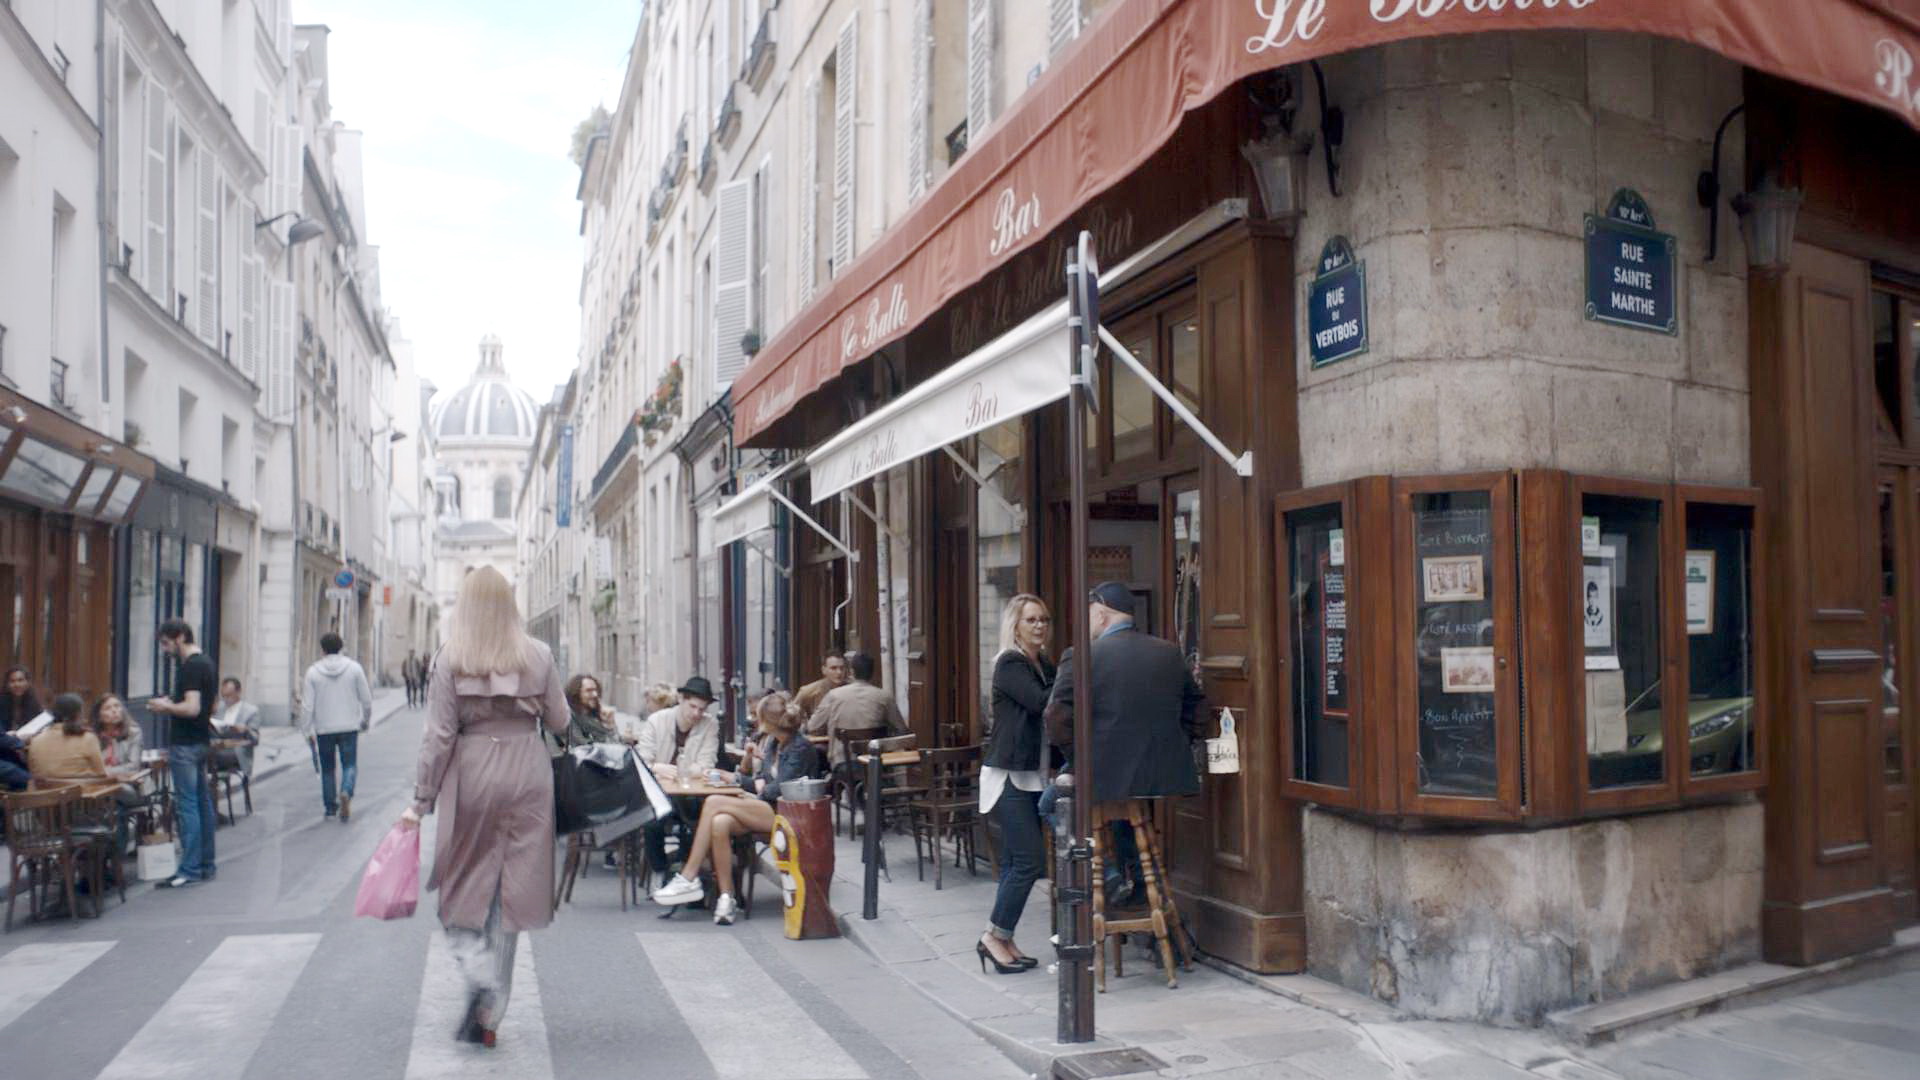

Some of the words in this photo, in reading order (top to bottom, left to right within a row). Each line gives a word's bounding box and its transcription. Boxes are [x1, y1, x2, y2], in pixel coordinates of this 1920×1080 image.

[990, 188, 1041, 256] Bar
[1621, 242, 1644, 263] RUE
[1614, 266, 1653, 290] SAINTE
[1326, 286, 1345, 309] RUE
[1611, 291, 1656, 316] MARTHE
[1315, 319, 1359, 349] VERTBOIS
[966, 382, 999, 430] Bar
